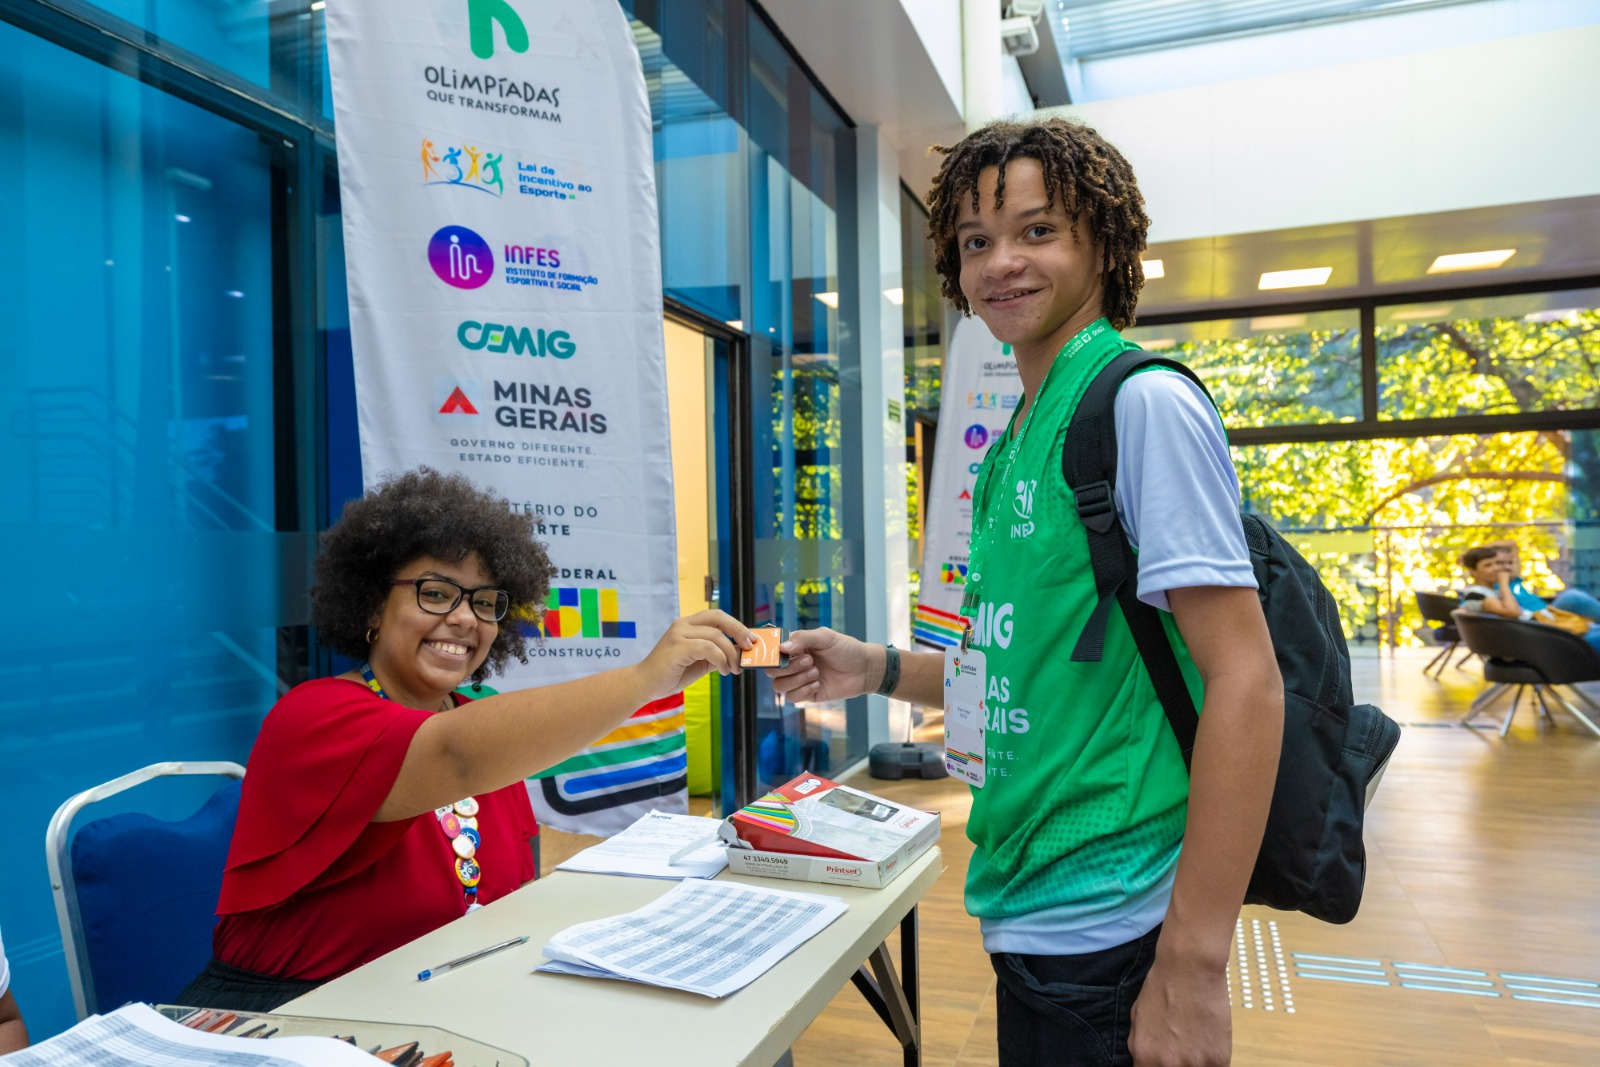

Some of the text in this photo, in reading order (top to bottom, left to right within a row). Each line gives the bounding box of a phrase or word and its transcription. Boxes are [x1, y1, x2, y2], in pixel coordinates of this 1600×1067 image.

[426, 89, 562, 123] QUE TRANSFORMAM
[517, 161, 555, 175] Lei de
[518, 173, 592, 193] Incentivo ao
[519, 185, 567, 200] Esporte
[504, 244, 561, 268] INFES
[505, 267, 598, 285] INSTITUTO DE FORMAÇÃO
[506, 276, 582, 291] ESPORTIVA E SOCIAL
[457, 320, 577, 360] CEMIG
[493, 380, 592, 409] MINAS
[495, 405, 608, 435] GERAIS
[450, 438, 515, 450] GOVERNO
[459, 452, 512, 464] ESTADO
[508, 501, 598, 518] TÉRIO DO
[537, 524, 570, 536] RTE
[968, 602, 1014, 649] MIG
[528, 646, 621, 658] CONSTRUÇÃO
[987, 675, 1010, 703] AS
[985, 704, 1030, 734] RAIS
[826, 866, 858, 874] Printset
